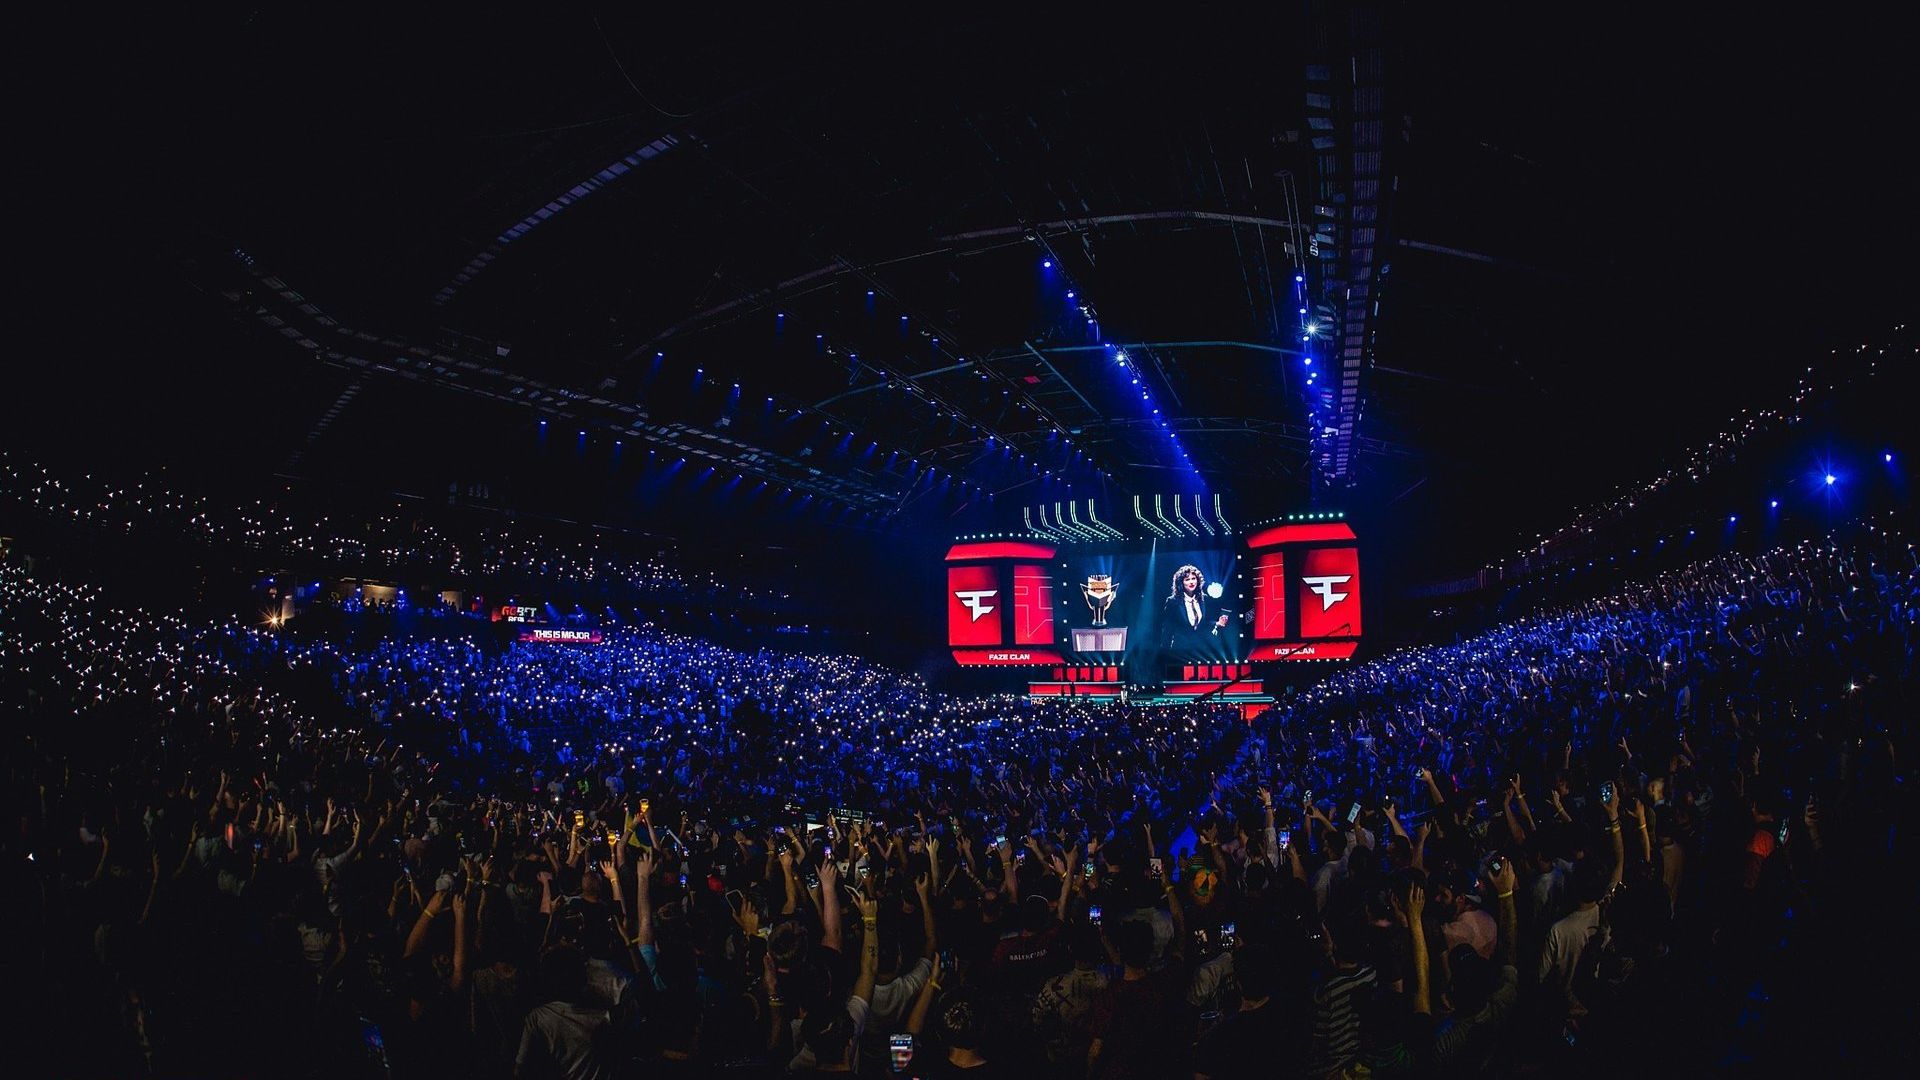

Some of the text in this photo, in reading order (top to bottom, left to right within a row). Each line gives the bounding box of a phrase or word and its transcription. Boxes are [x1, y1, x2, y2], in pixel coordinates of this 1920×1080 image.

[533, 630, 590, 640] THIS IS MAJOR
